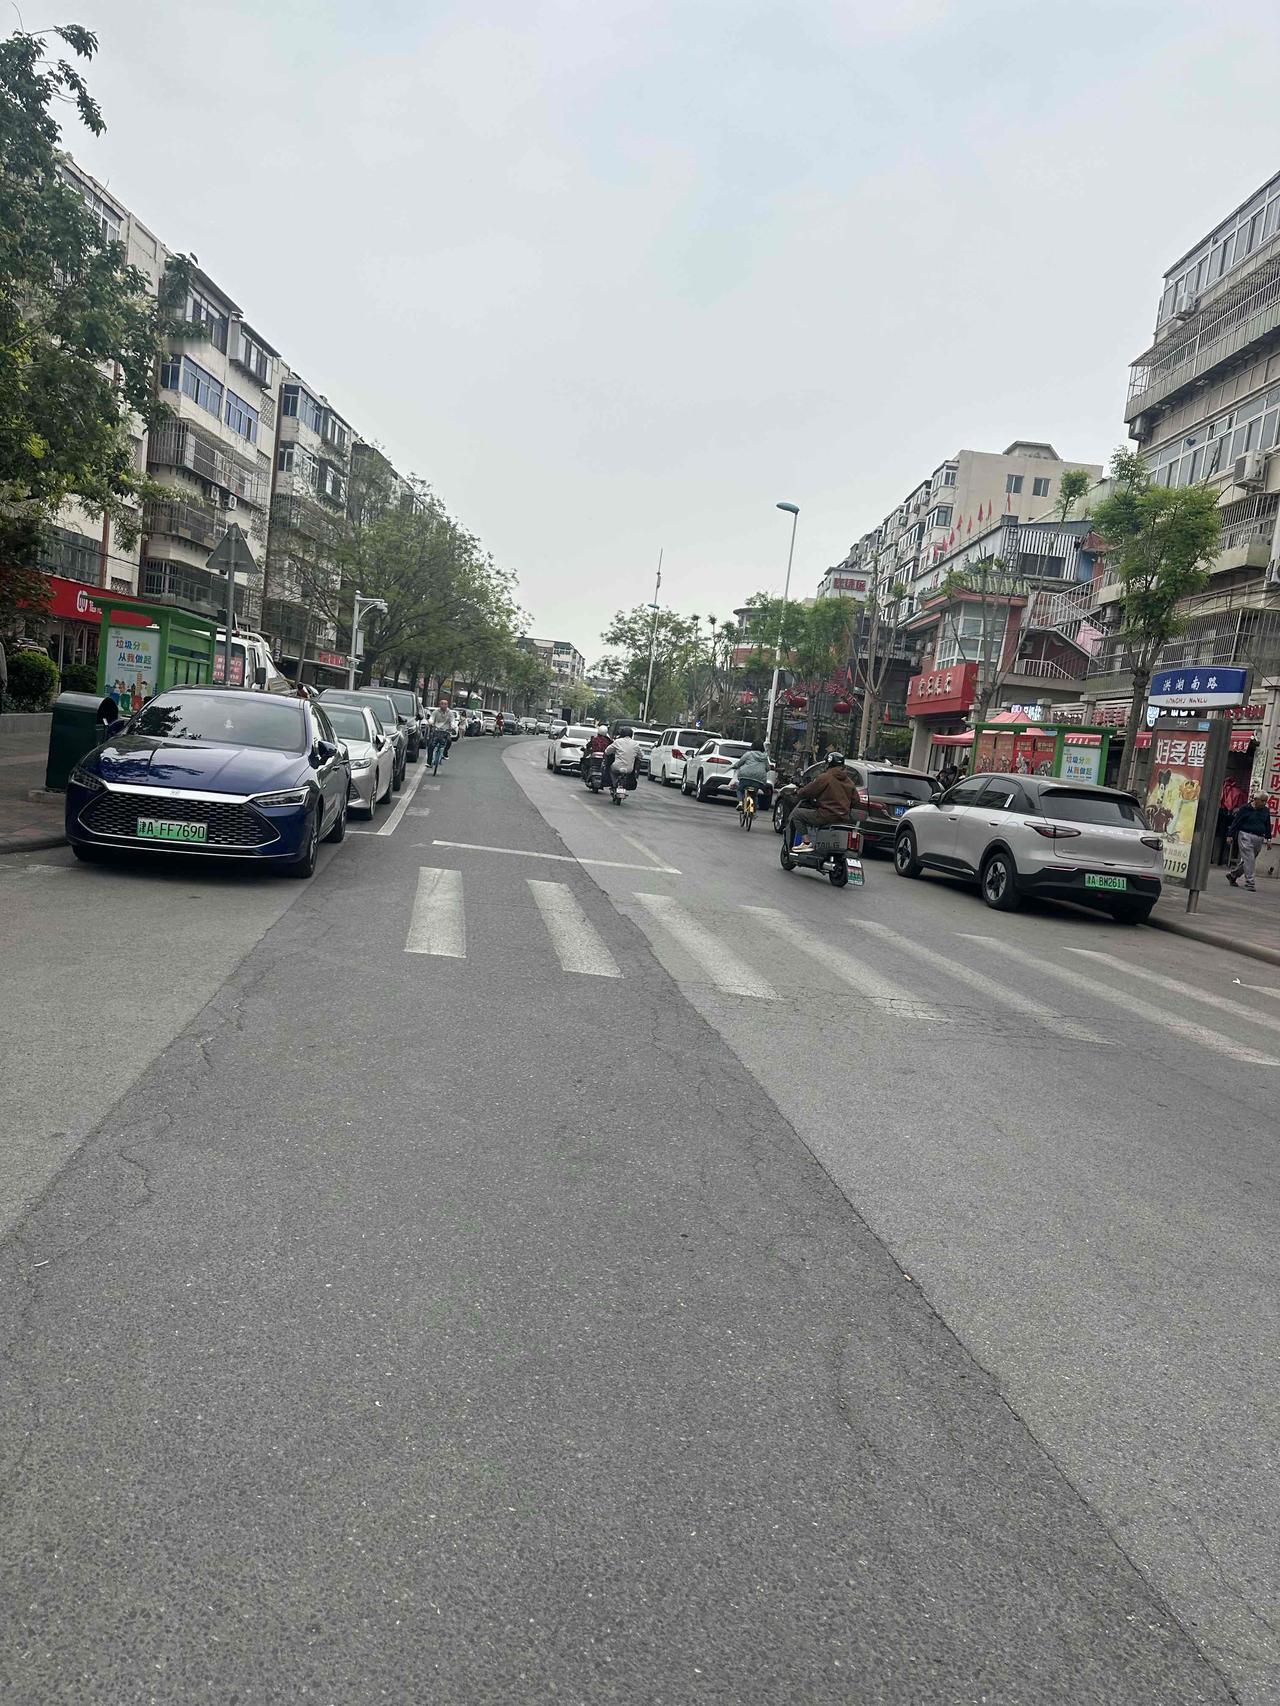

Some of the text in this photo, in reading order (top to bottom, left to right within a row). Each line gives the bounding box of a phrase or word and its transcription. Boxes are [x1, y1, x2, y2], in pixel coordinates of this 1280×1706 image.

[118, 652, 152, 665] 从我做起
[1162, 676, 1218, 691] 洪湖南路
[1154, 738, 1207, 768] 好多蟹
